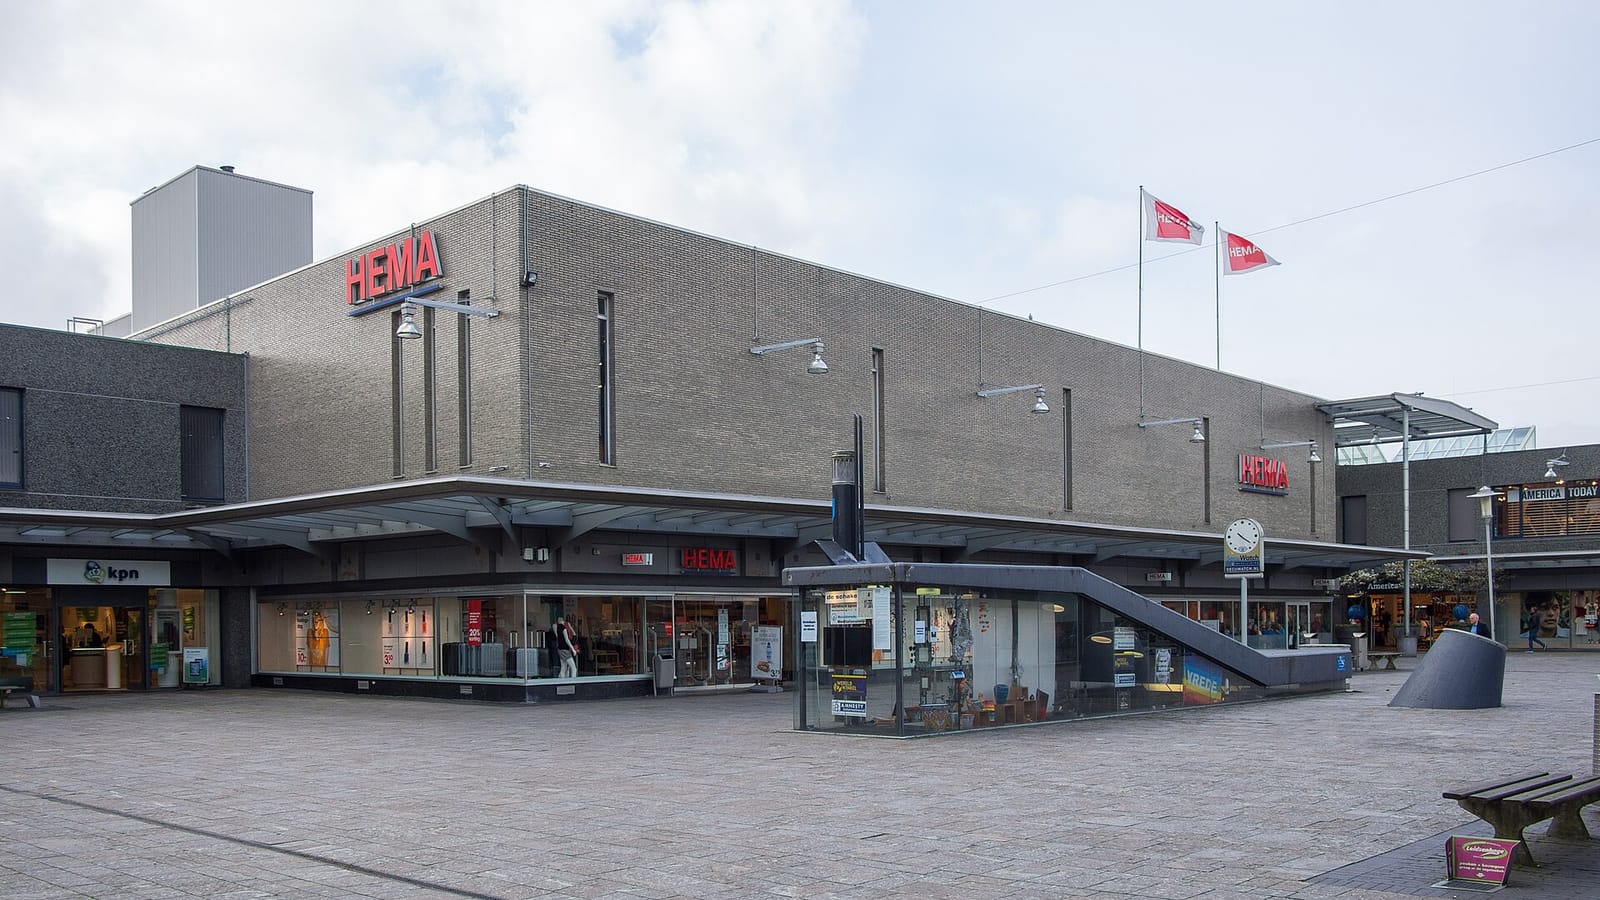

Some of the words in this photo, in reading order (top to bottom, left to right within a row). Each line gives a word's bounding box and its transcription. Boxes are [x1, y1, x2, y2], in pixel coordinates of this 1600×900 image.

[1229, 246, 1261, 257] HEMA
[345, 230, 440, 305] HEMA
[1240, 453, 1290, 489] HEMA
[1523, 488, 1561, 500] AMERICA
[1568, 486, 1598, 498] TODAY
[625, 554, 644, 563] HEMA
[683, 547, 737, 570] HEMA
[107, 566, 139, 582] kpn
[1367, 582, 1399, 590] America
[469, 628, 481, 636] 20%
[1187, 669, 1218, 693] VREDE
